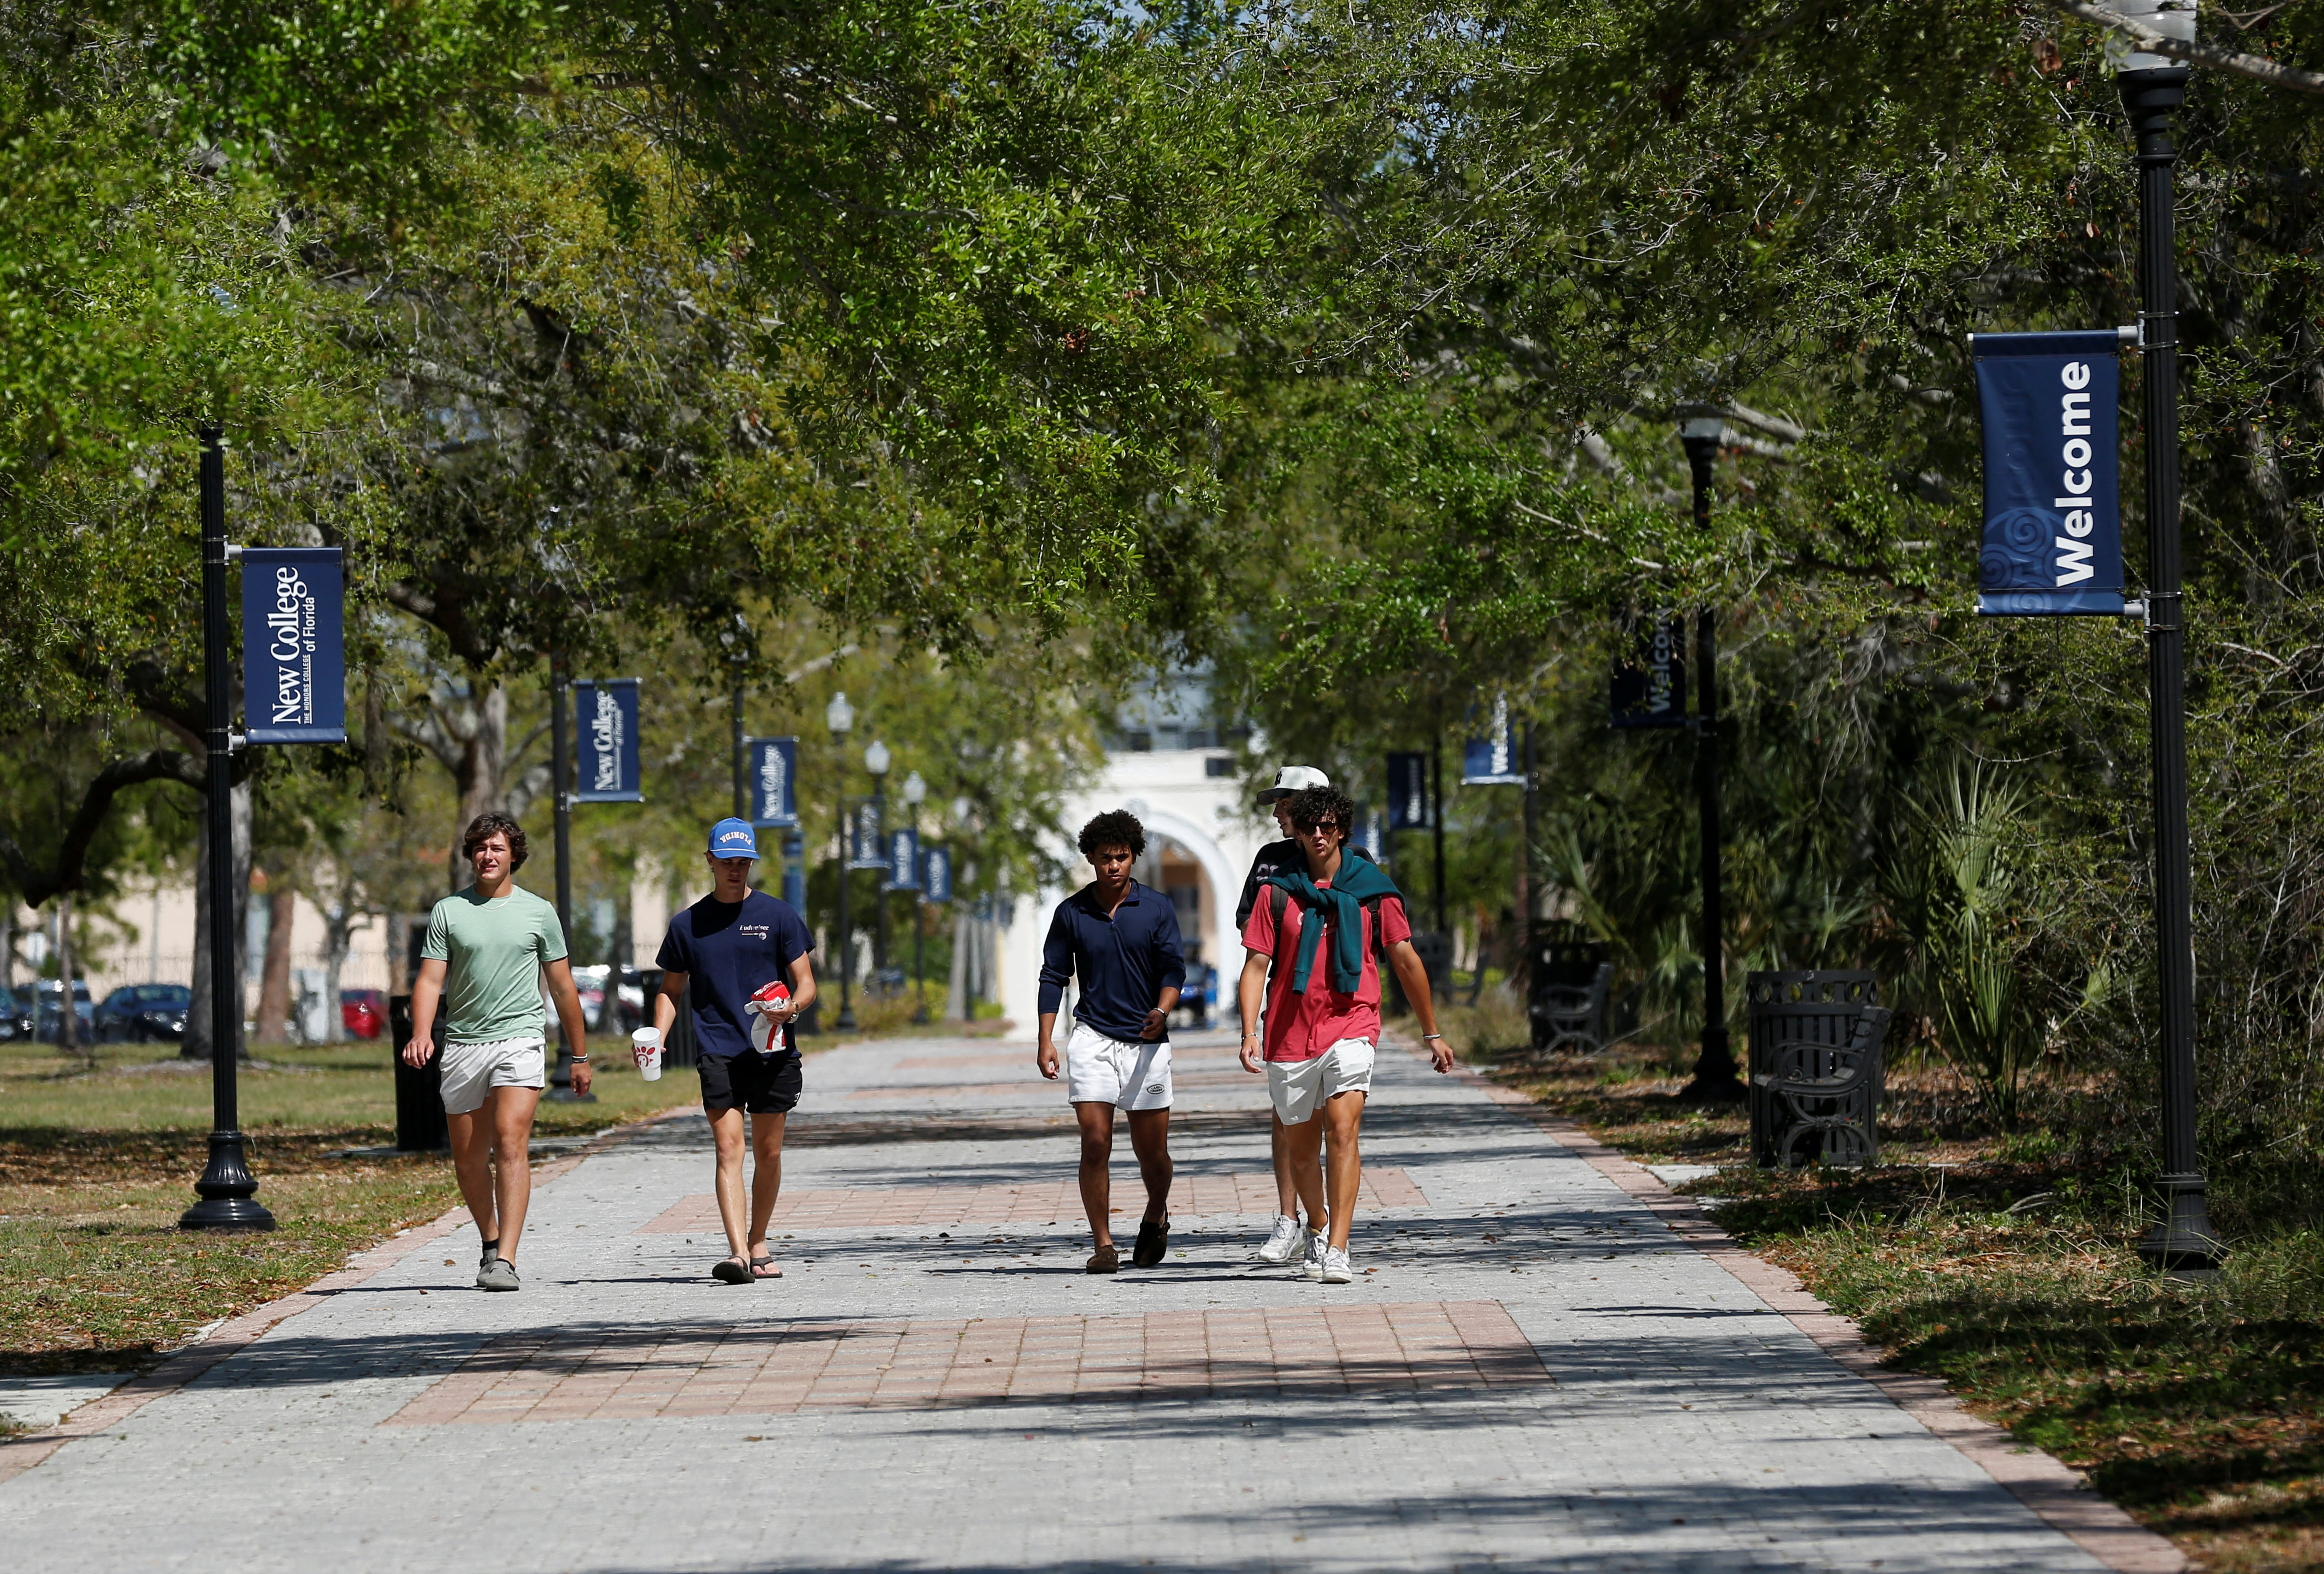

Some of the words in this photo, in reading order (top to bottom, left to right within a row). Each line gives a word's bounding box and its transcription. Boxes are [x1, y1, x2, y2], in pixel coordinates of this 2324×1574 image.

[2054, 361, 2095, 587] Welcome
[267, 566, 307, 661] College
[302, 597, 315, 637] Florida
[303, 639, 316, 652] of
[272, 665, 301, 725] New
[591, 690, 619, 752] College
[594, 752, 614, 791] New
[719, 831, 752, 846] FLORIDA
